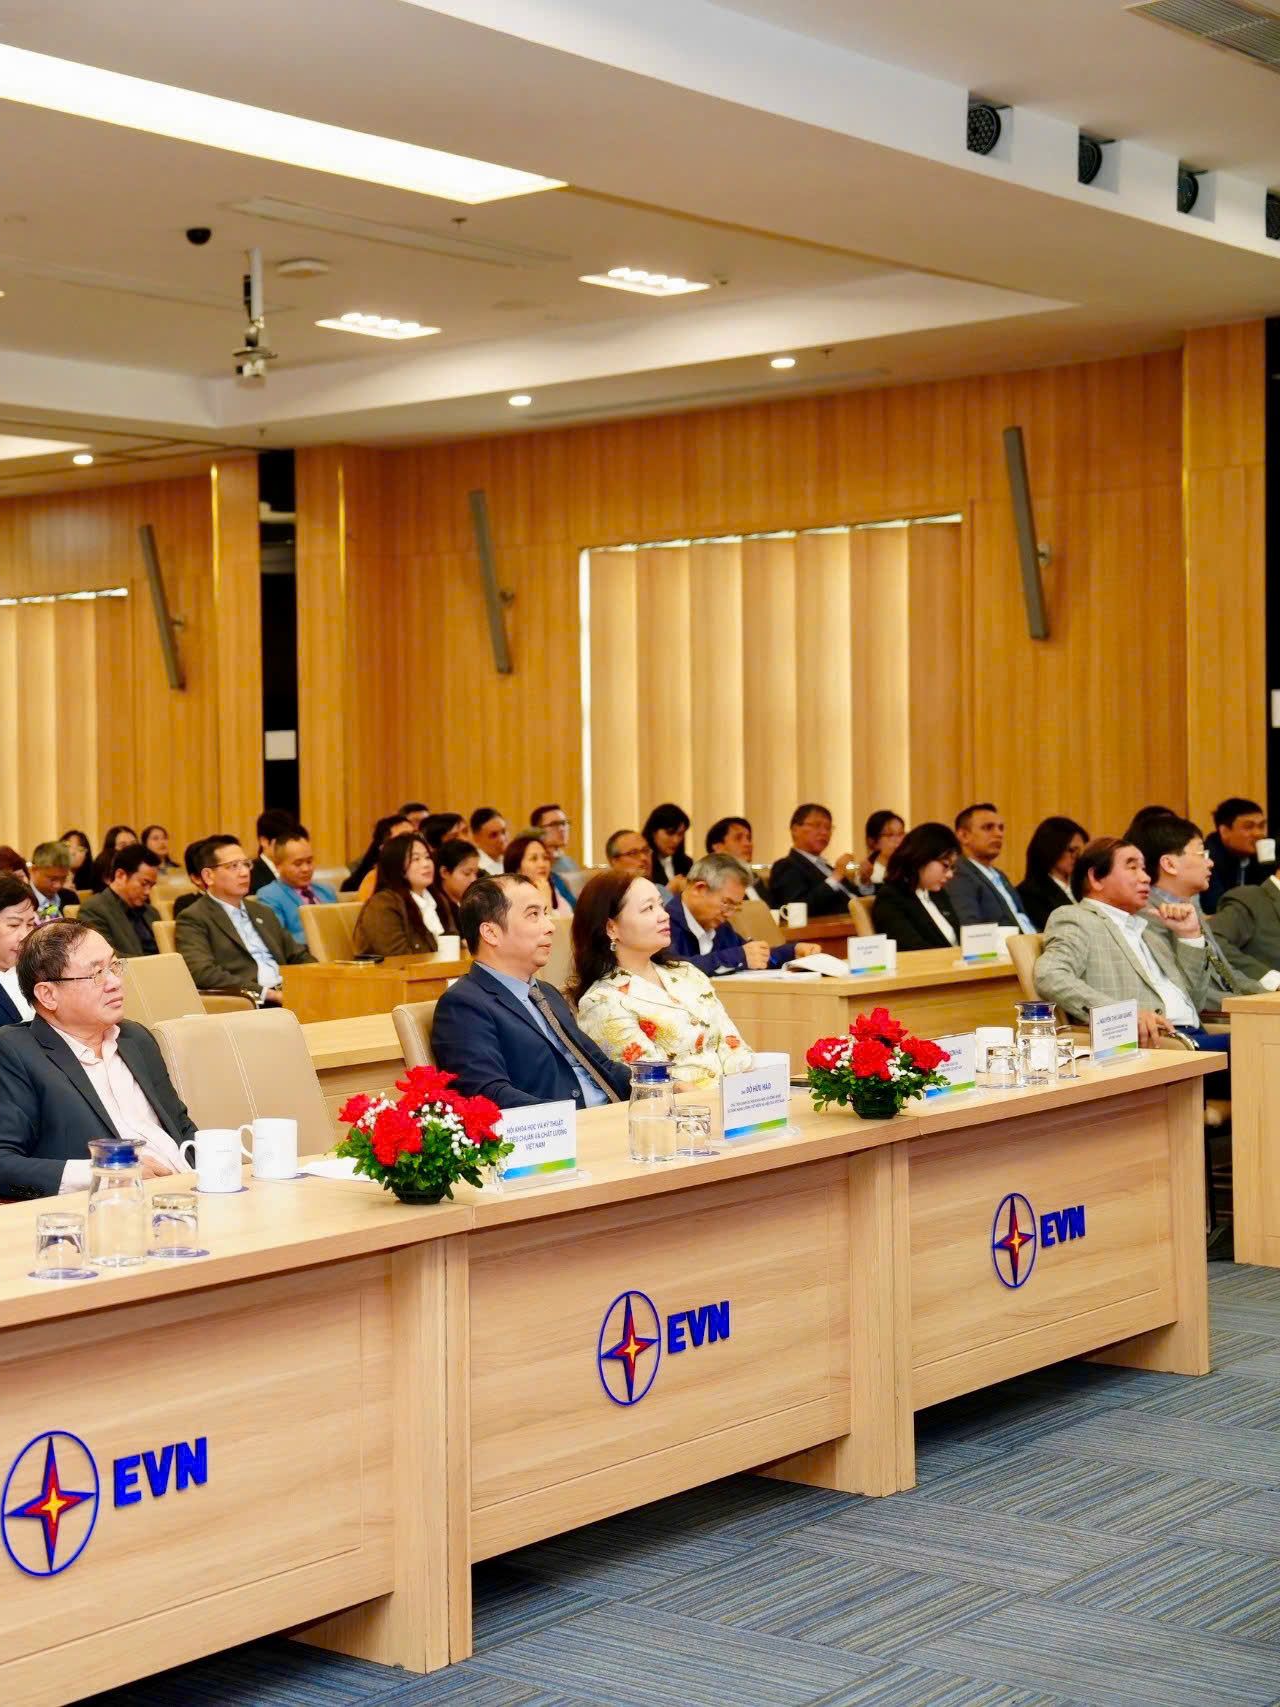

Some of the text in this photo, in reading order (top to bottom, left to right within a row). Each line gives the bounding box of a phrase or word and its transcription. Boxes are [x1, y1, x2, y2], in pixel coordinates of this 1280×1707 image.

[1040, 1205, 1086, 1248] EVN
[667, 1300, 730, 1355] EVN
[113, 1436, 208, 1509] EVN
